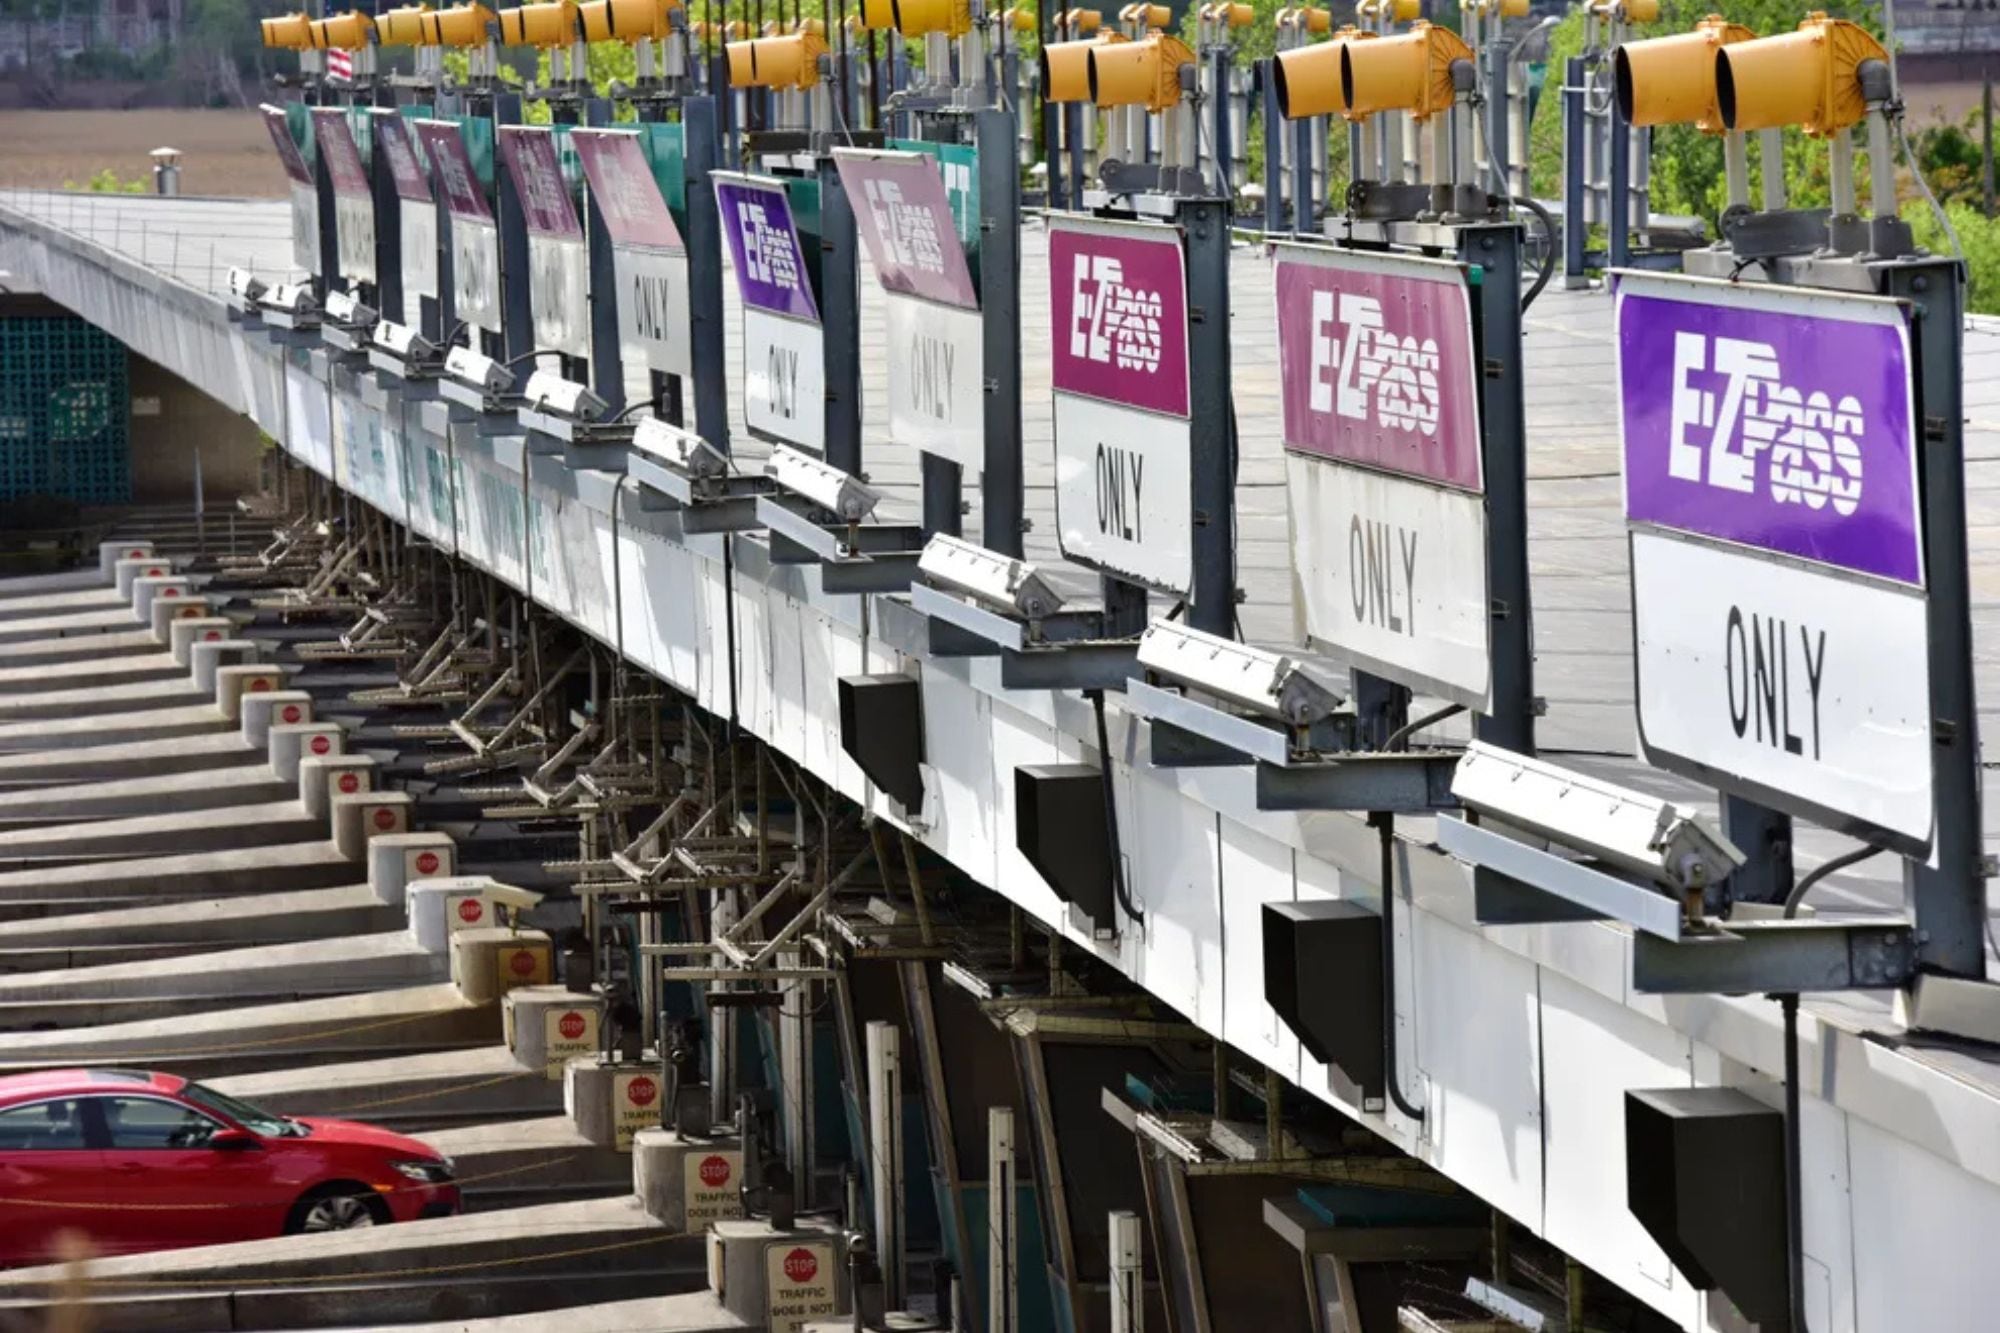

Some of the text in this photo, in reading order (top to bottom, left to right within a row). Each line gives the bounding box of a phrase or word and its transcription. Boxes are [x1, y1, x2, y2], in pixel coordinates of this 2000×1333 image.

[634, 274, 668, 341] ONLY
[768, 344, 798, 420] ONLY
[911, 331, 954, 424] ONLY
[1096, 442, 1143, 543] ONLY
[1349, 513, 1417, 637] ONLY
[1726, 604, 1826, 761] ONLY
[560, 1020, 585, 1031] STOP
[629, 1085, 655, 1096] STOP
[701, 1165, 729, 1177] STOP
[694, 1192, 738, 1203] TRAFFIC
[688, 1207, 718, 1218] DOES
[785, 1259, 816, 1272] STOP
[778, 1287, 826, 1299] TRAFFIC
[773, 1302, 833, 1317] DOES NOT
